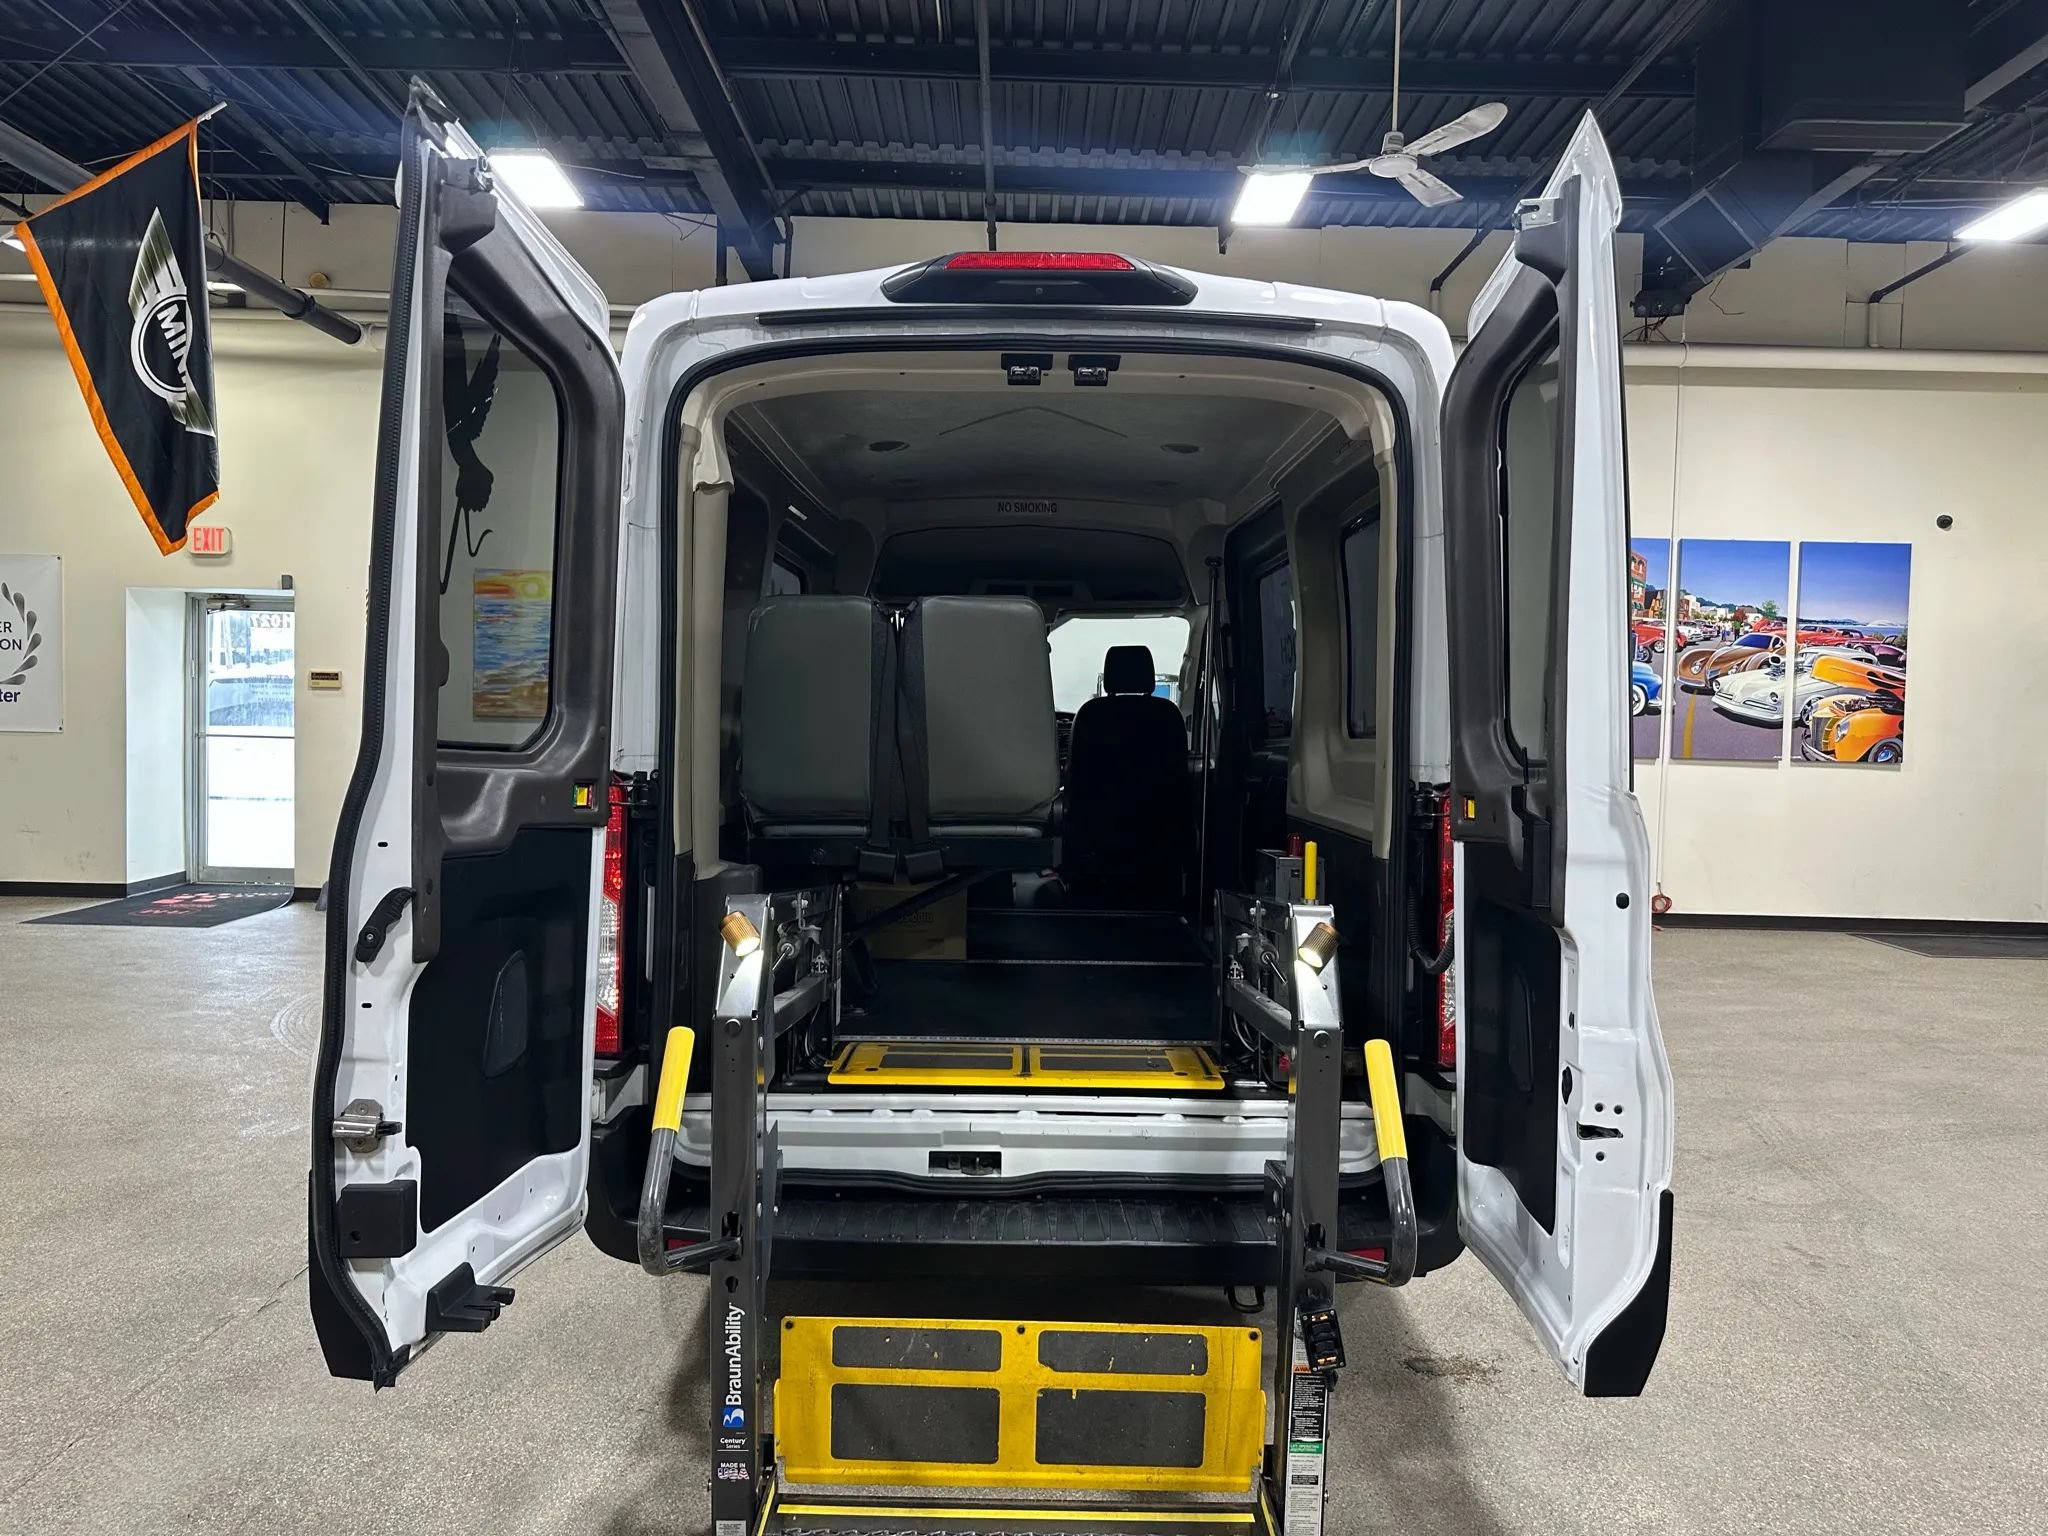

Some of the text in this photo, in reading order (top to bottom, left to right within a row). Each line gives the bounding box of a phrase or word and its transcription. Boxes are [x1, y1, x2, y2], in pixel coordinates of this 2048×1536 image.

[157, 304, 187, 384] MIN
[998, 502, 1057, 513] NO SMOKING
[193, 527, 225, 551] EXIT
[725, 1302, 745, 1405] BraunAbility
[720, 1437, 746, 1445] Century
[718, 1467, 750, 1480] USA
